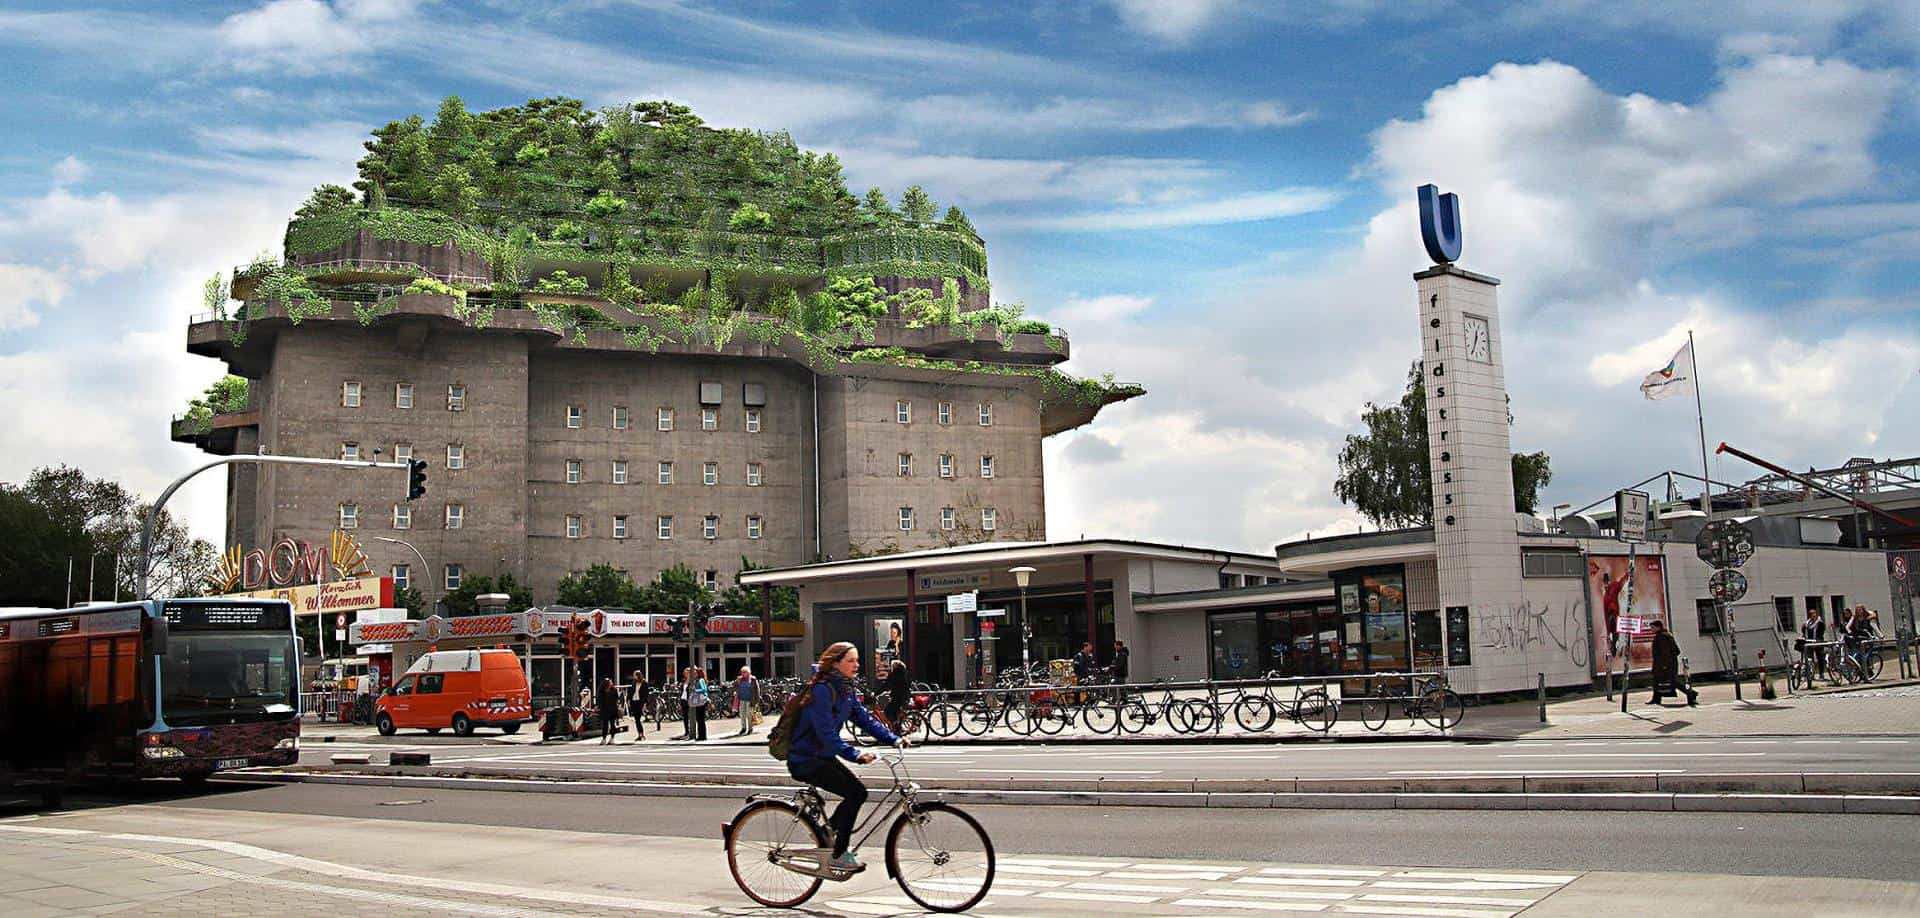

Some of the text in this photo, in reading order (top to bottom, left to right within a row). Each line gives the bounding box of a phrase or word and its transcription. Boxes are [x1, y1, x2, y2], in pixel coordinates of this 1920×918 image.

[1417, 184, 1462, 264] U
[1430, 294, 1456, 526] feldstrasse
[244, 537, 328, 589] DOM
[320, 580, 362, 595] Herzlich
[611, 620, 621, 628] THE
[622, 620, 634, 628] BEST
[635, 620, 646, 628] ONE
